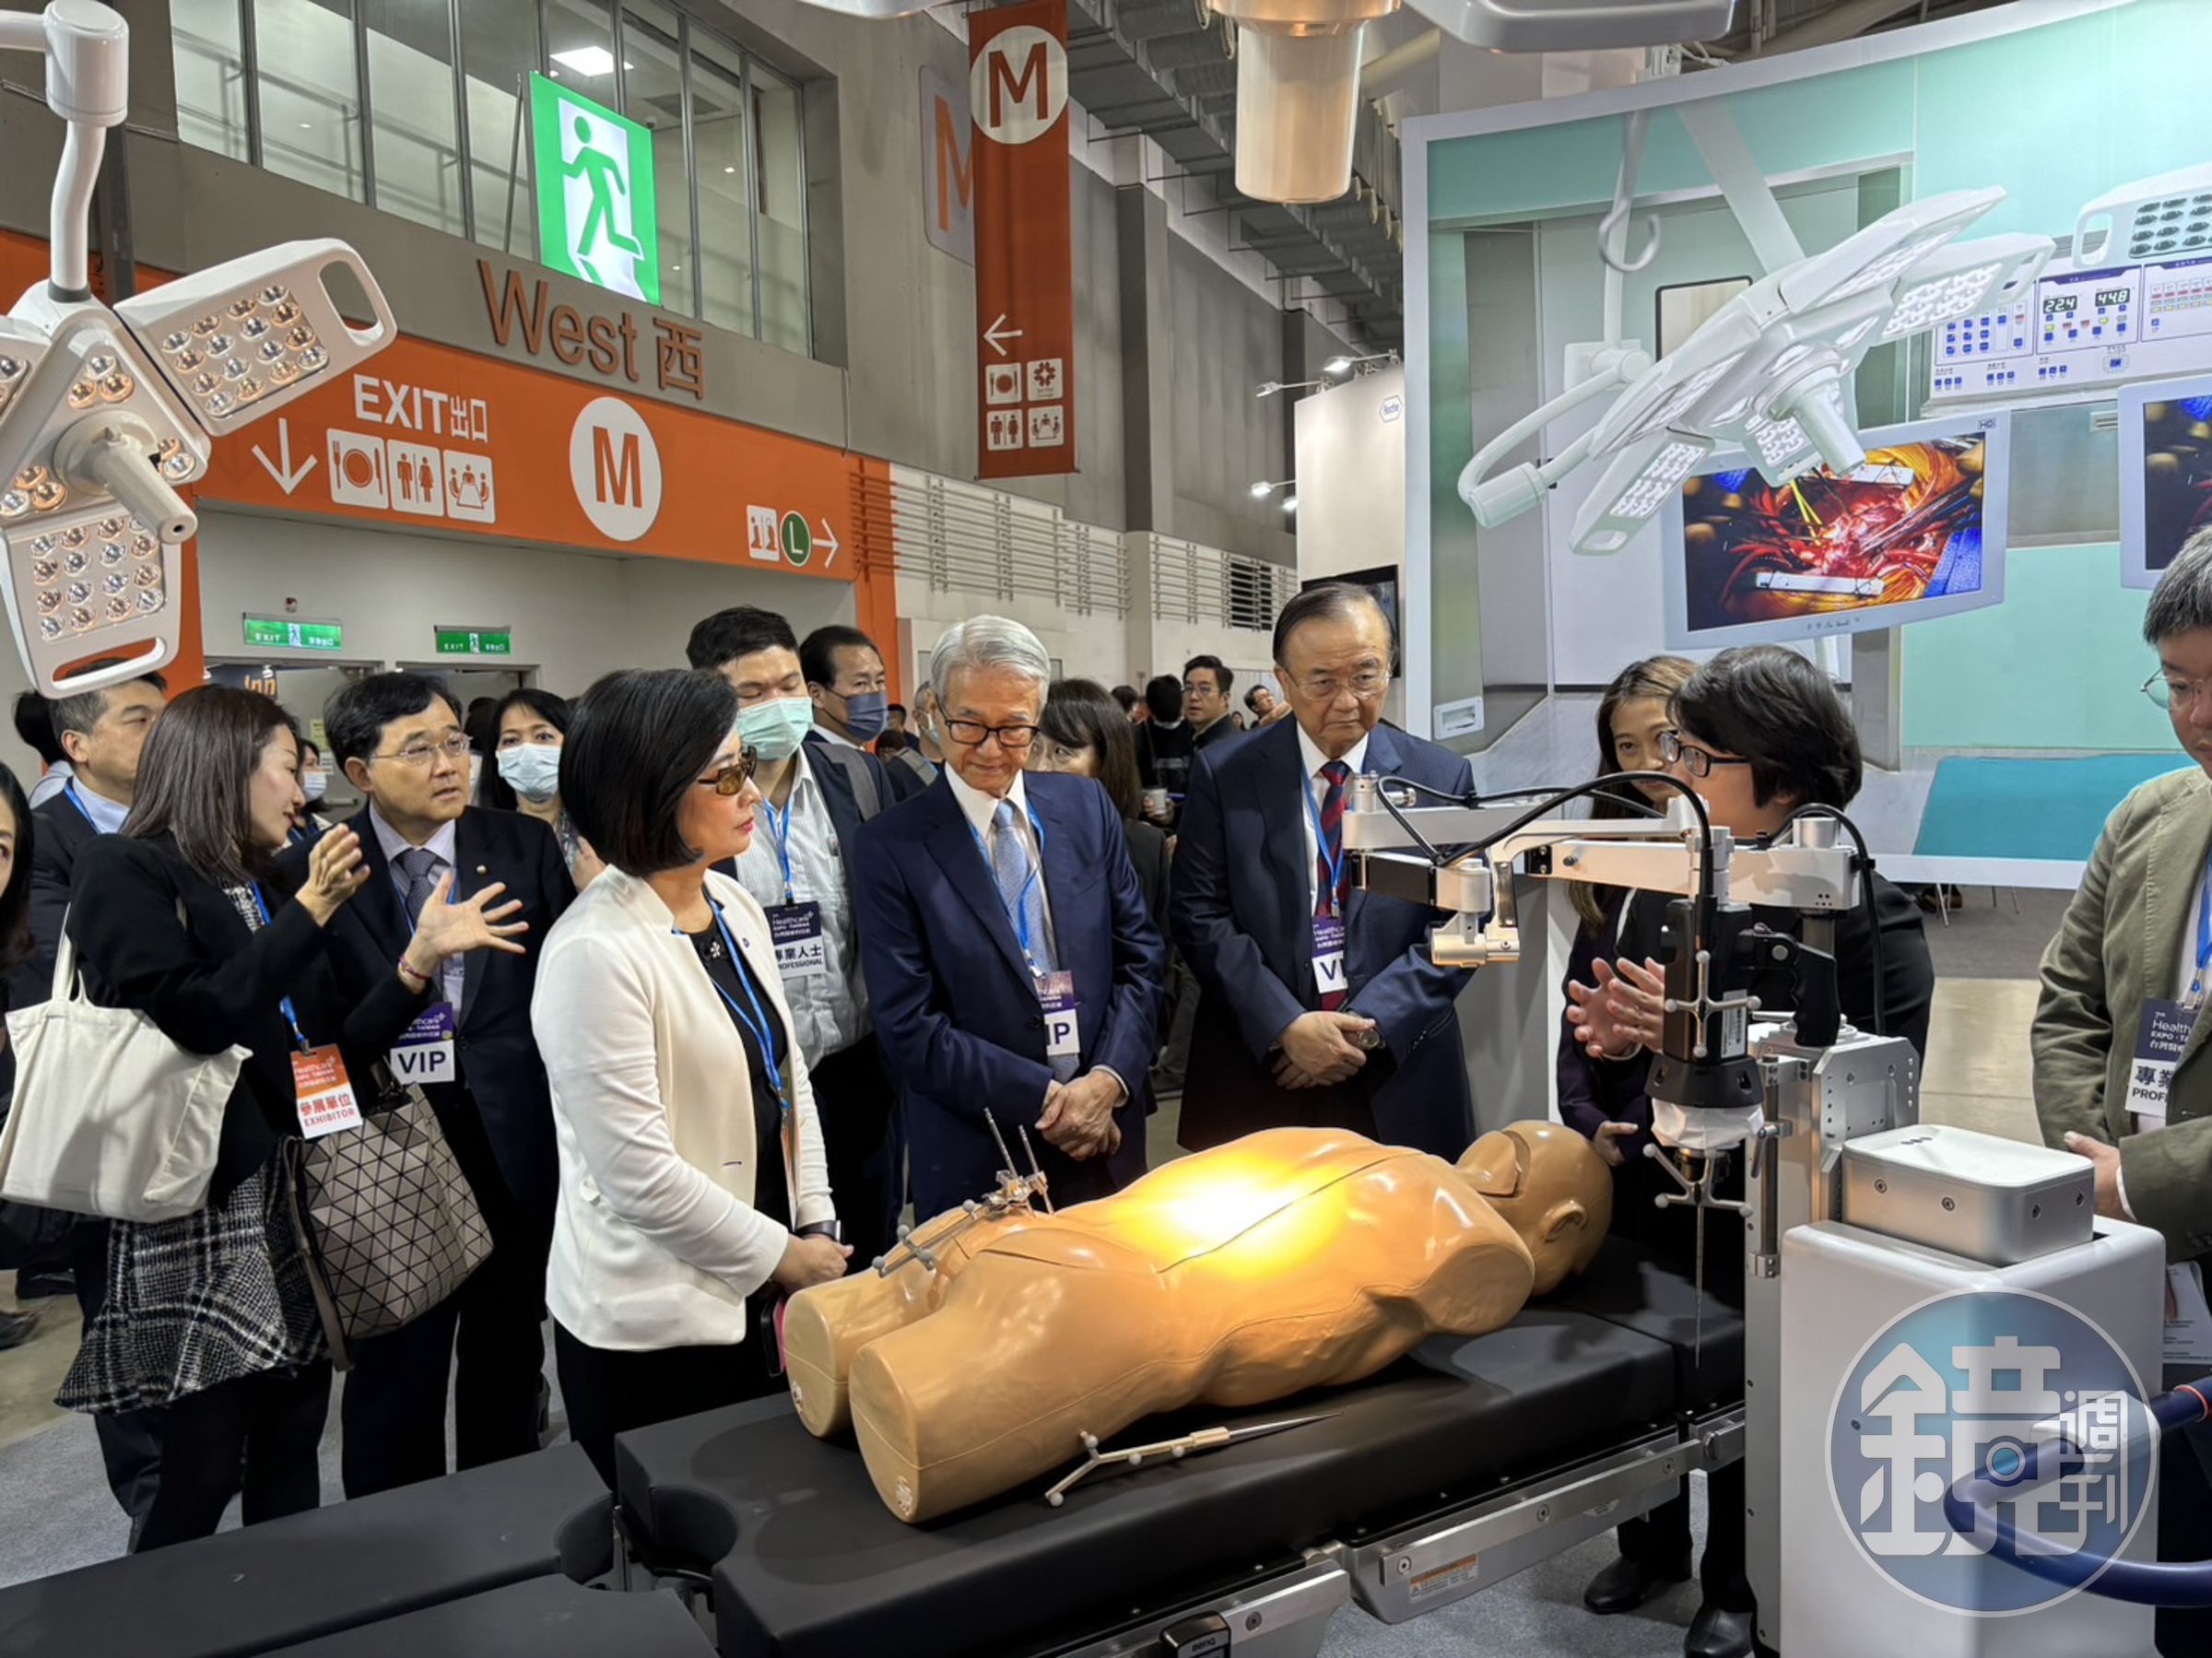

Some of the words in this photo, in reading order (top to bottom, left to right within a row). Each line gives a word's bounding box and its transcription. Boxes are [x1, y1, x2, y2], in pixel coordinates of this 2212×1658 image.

[987, 41, 1050, 129] M
[477, 258, 640, 382] West
[653, 316, 704, 400] 西
[592, 425, 643, 509] M
[789, 520, 805, 556] L
[254, 632, 281, 642] EXIT
[443, 642, 464, 651] EXIT
[779, 958, 823, 970] ROFESSIONAL
[2150, 1031, 2174, 1041] EXPO
[2151, 1019, 2192, 1034] Health
[397, 1050, 447, 1075] VIP
[2135, 1065, 2173, 1088] 專業
[2132, 1088, 2166, 1102] PROF
[303, 1107, 355, 1126] EXHIBITOR
